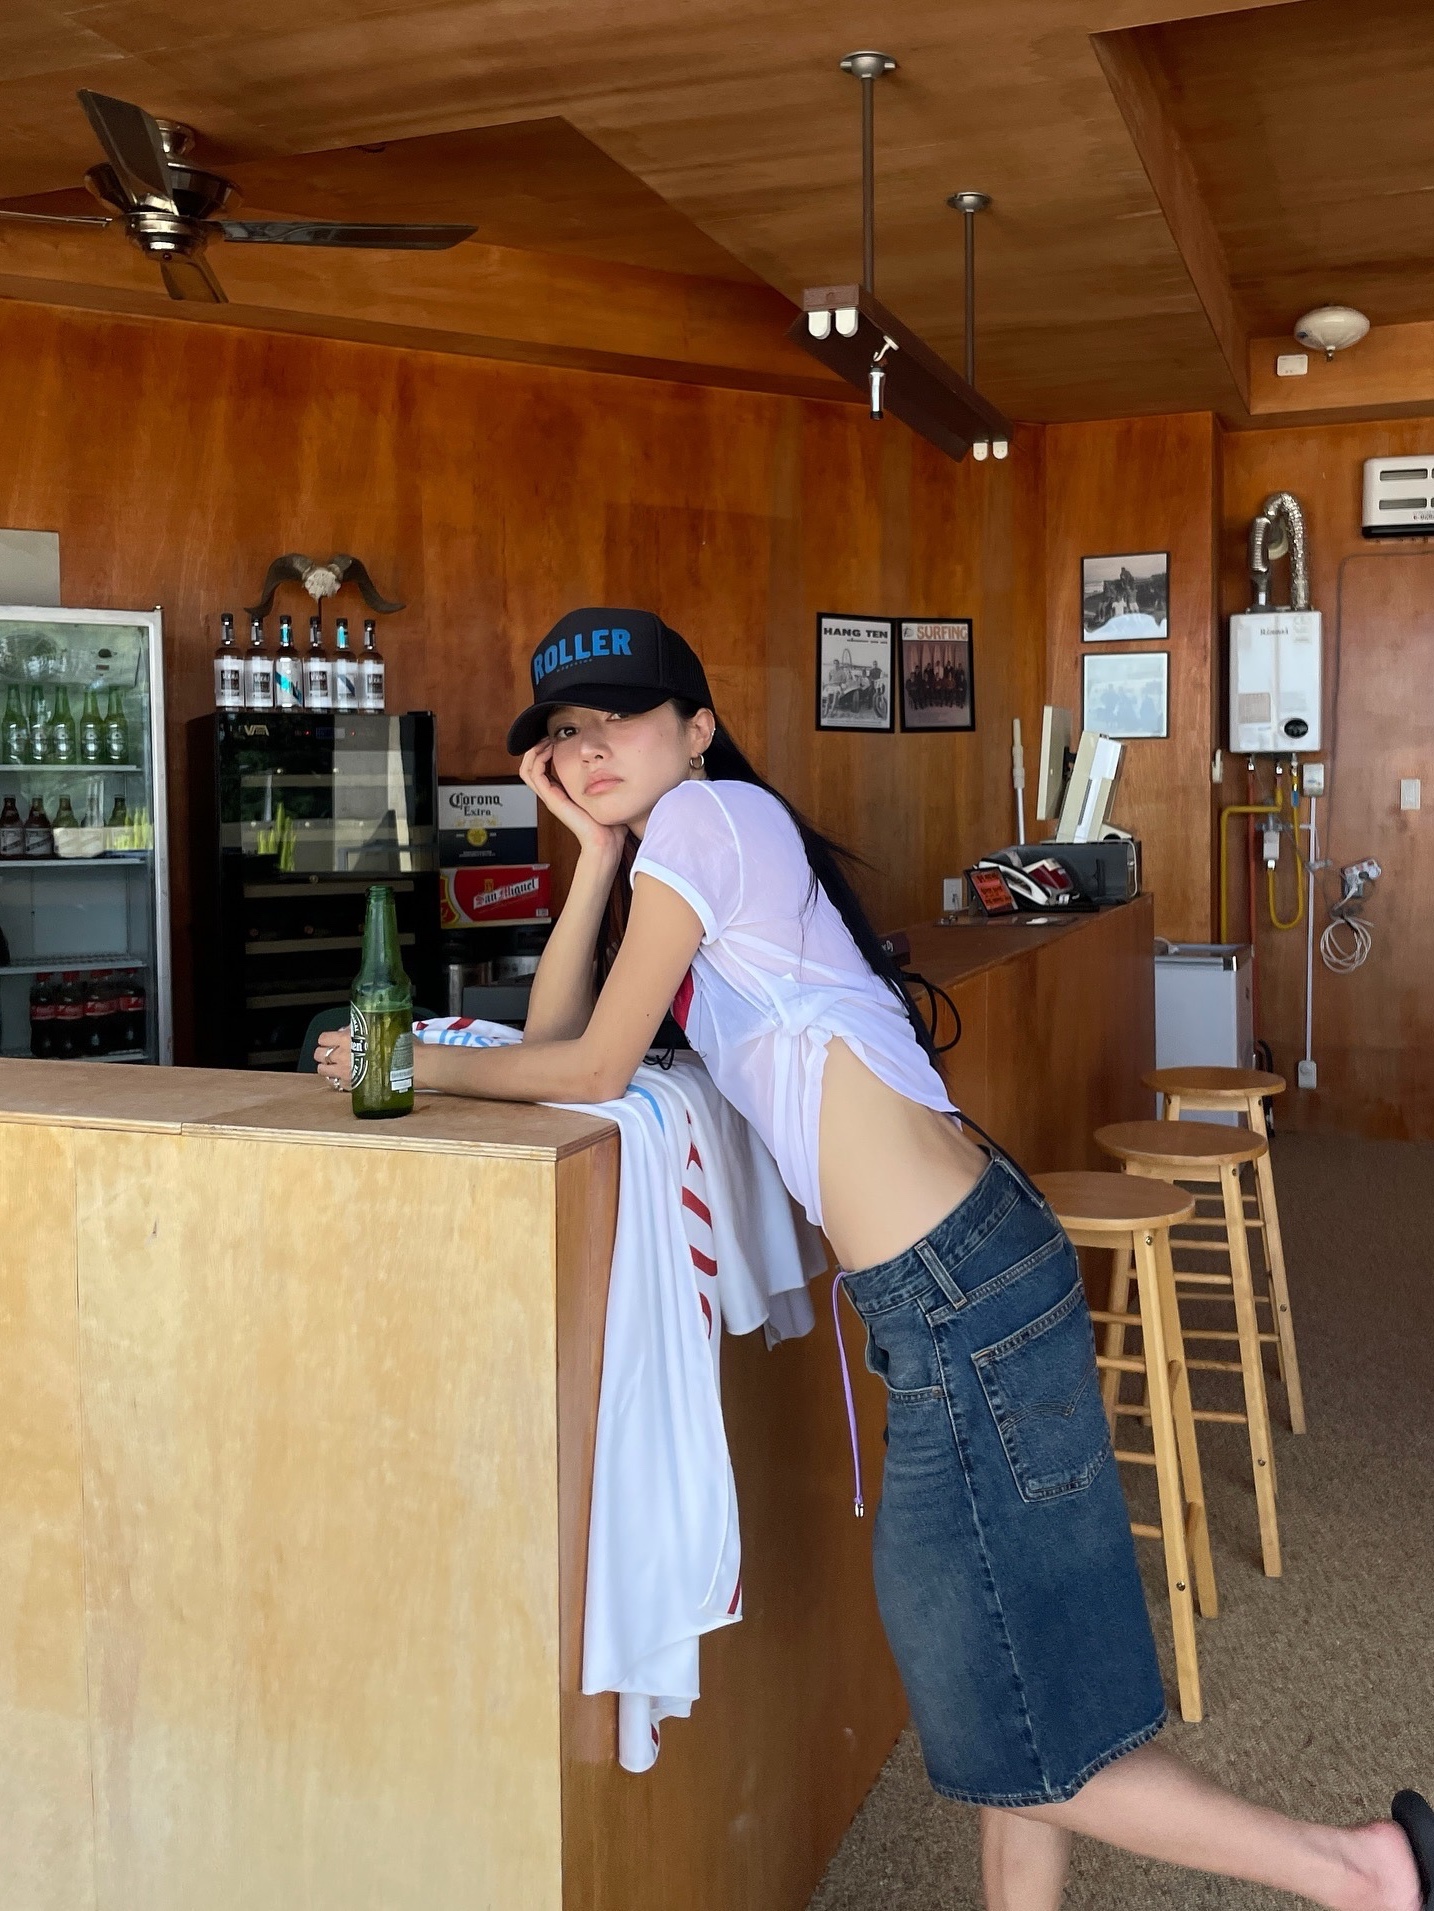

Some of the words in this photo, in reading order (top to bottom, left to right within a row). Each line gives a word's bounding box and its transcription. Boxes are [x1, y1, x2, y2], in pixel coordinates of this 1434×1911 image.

[823, 627, 861, 638] HANG
[865, 629, 888, 639] TEN
[916, 624, 968, 640] SURFING
[533, 628, 632, 686] ROLLER
[449, 792, 503, 810] Corona
[464, 806, 491, 817] Extra
[476, 893, 497, 906] San
[498, 879, 536, 900] Miguel
